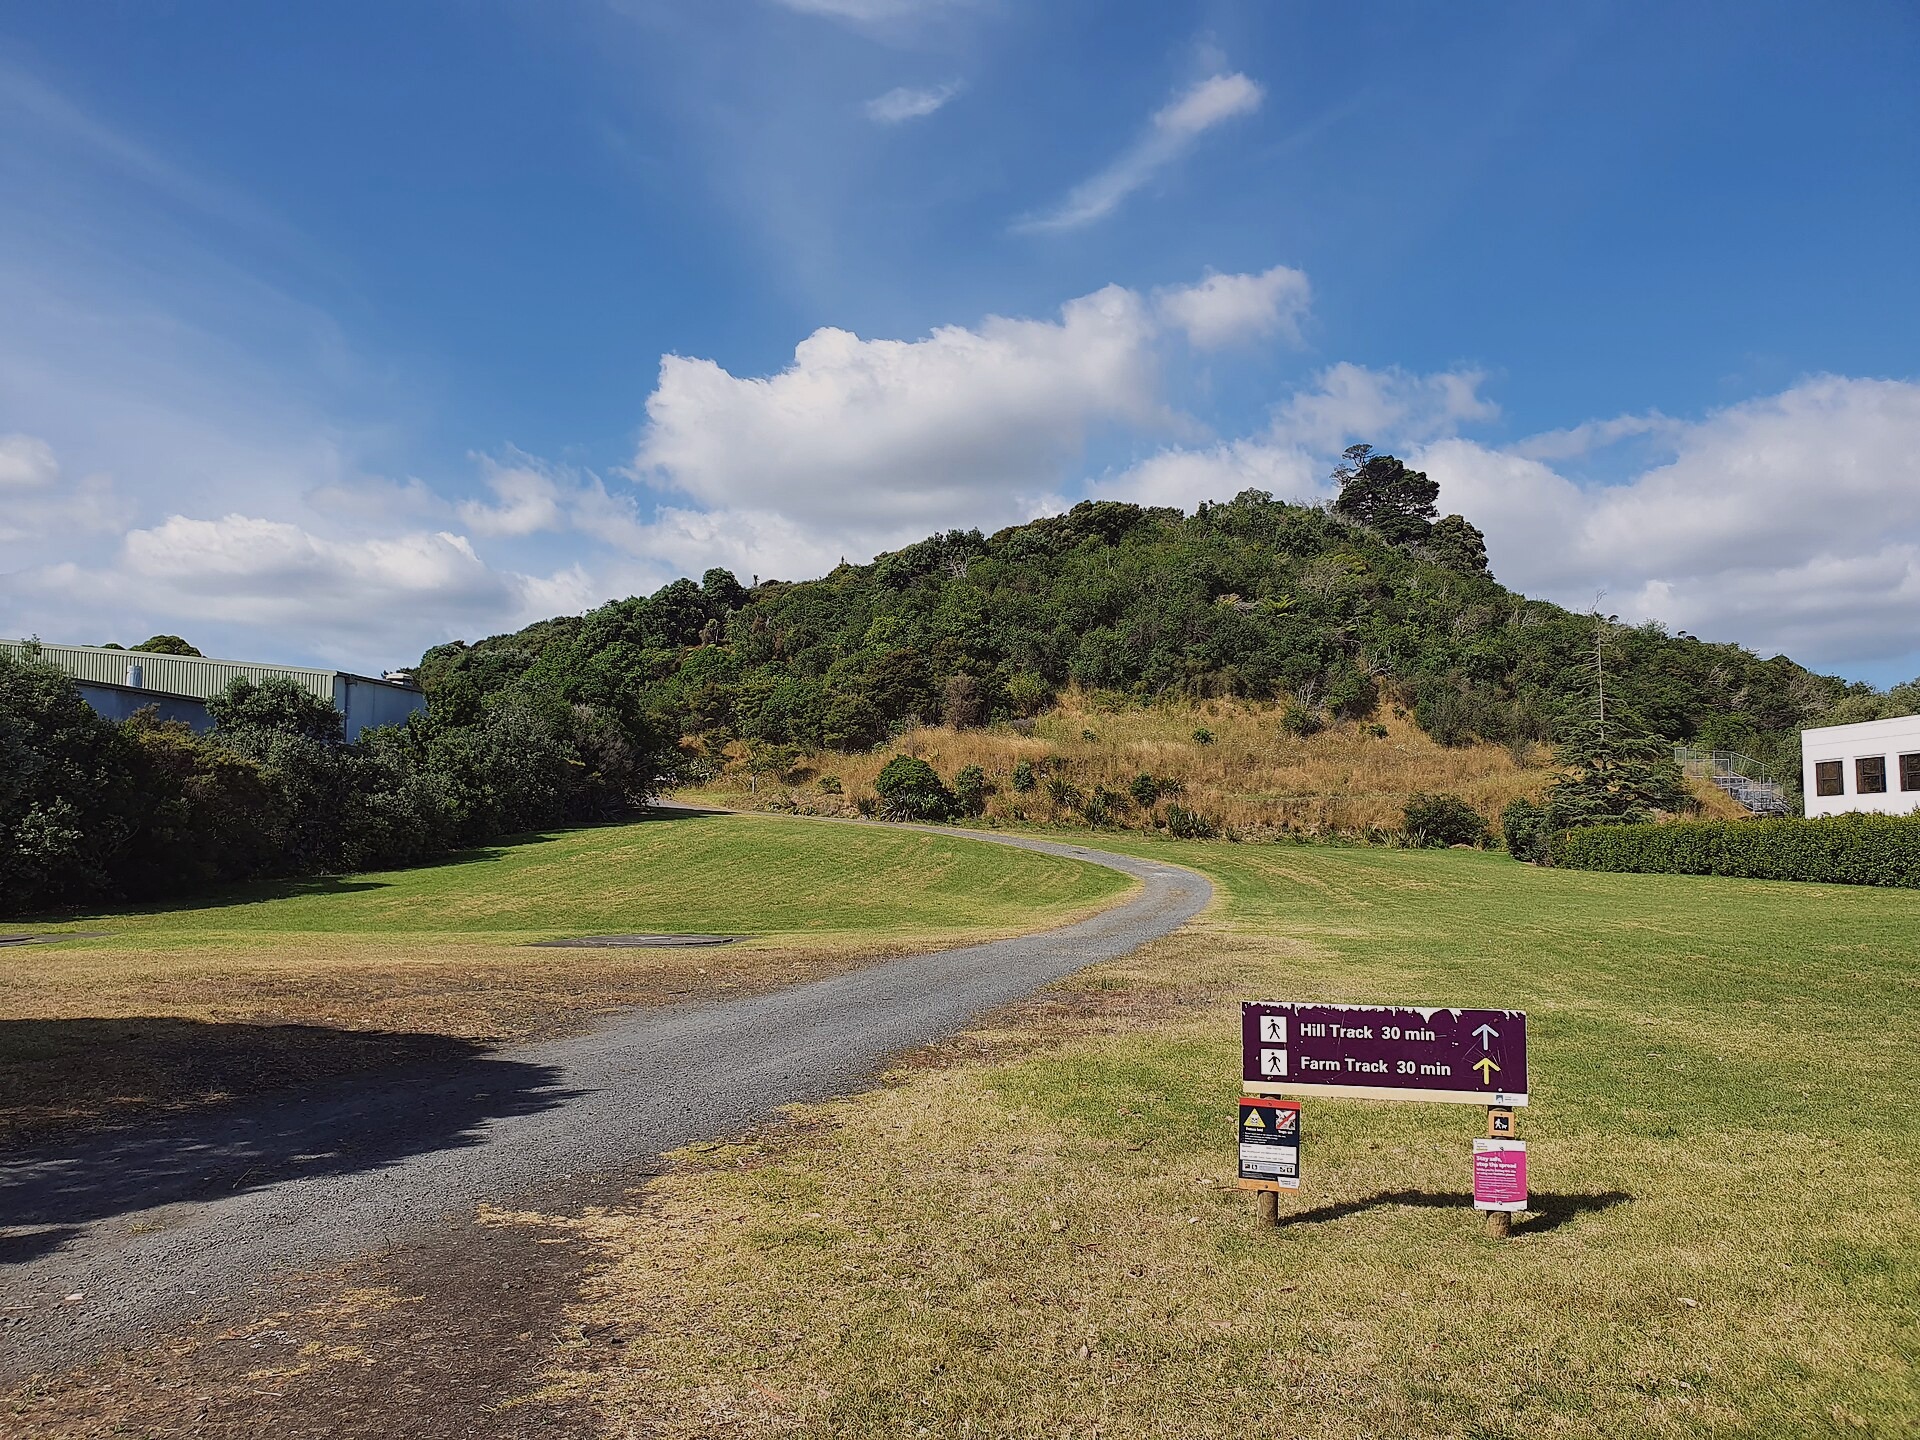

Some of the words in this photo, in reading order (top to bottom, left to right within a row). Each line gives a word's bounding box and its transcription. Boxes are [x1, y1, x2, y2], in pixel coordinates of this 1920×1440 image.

[1300, 1023, 1325, 1037] Hill
[1329, 1024, 1373, 1039] Track
[1381, 1026, 1401, 1040] 30
[1405, 1027, 1436, 1041] min
[1300, 1056, 1341, 1071] Farm
[1344, 1057, 1388, 1073] Track
[1396, 1060, 1416, 1074] 30
[1420, 1062, 1451, 1076] min
